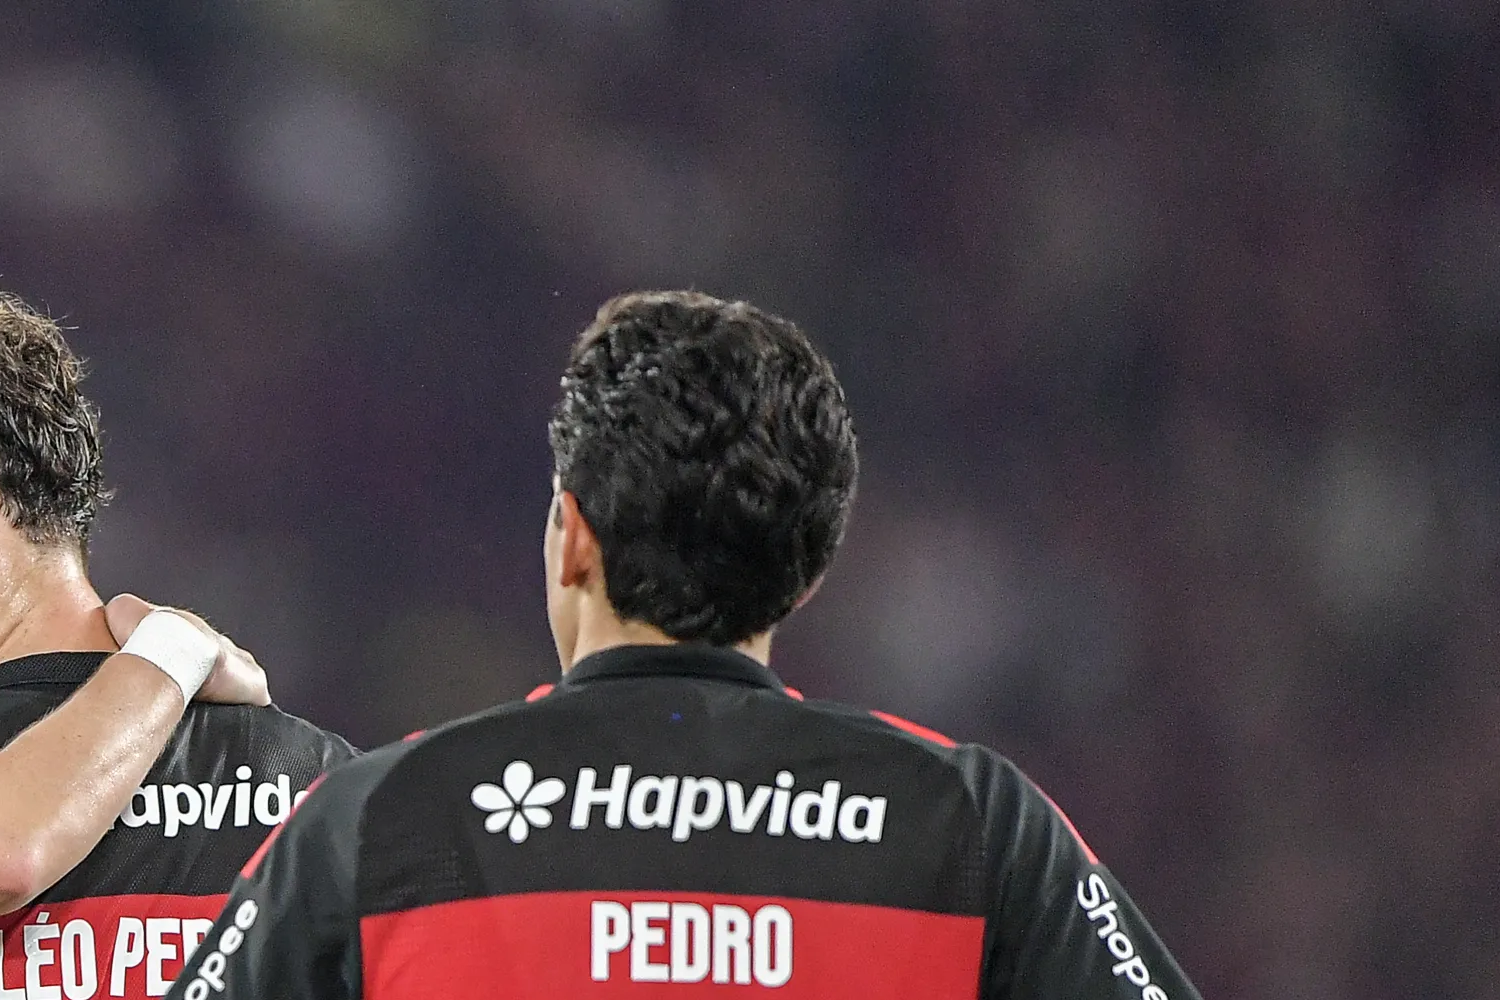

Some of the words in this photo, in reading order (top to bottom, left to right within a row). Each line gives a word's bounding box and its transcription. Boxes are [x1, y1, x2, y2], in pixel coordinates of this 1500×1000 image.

[109, 766, 309, 837] apvid
[569, 764, 888, 843] Hapvida
[590, 900, 794, 988] PEDRO
